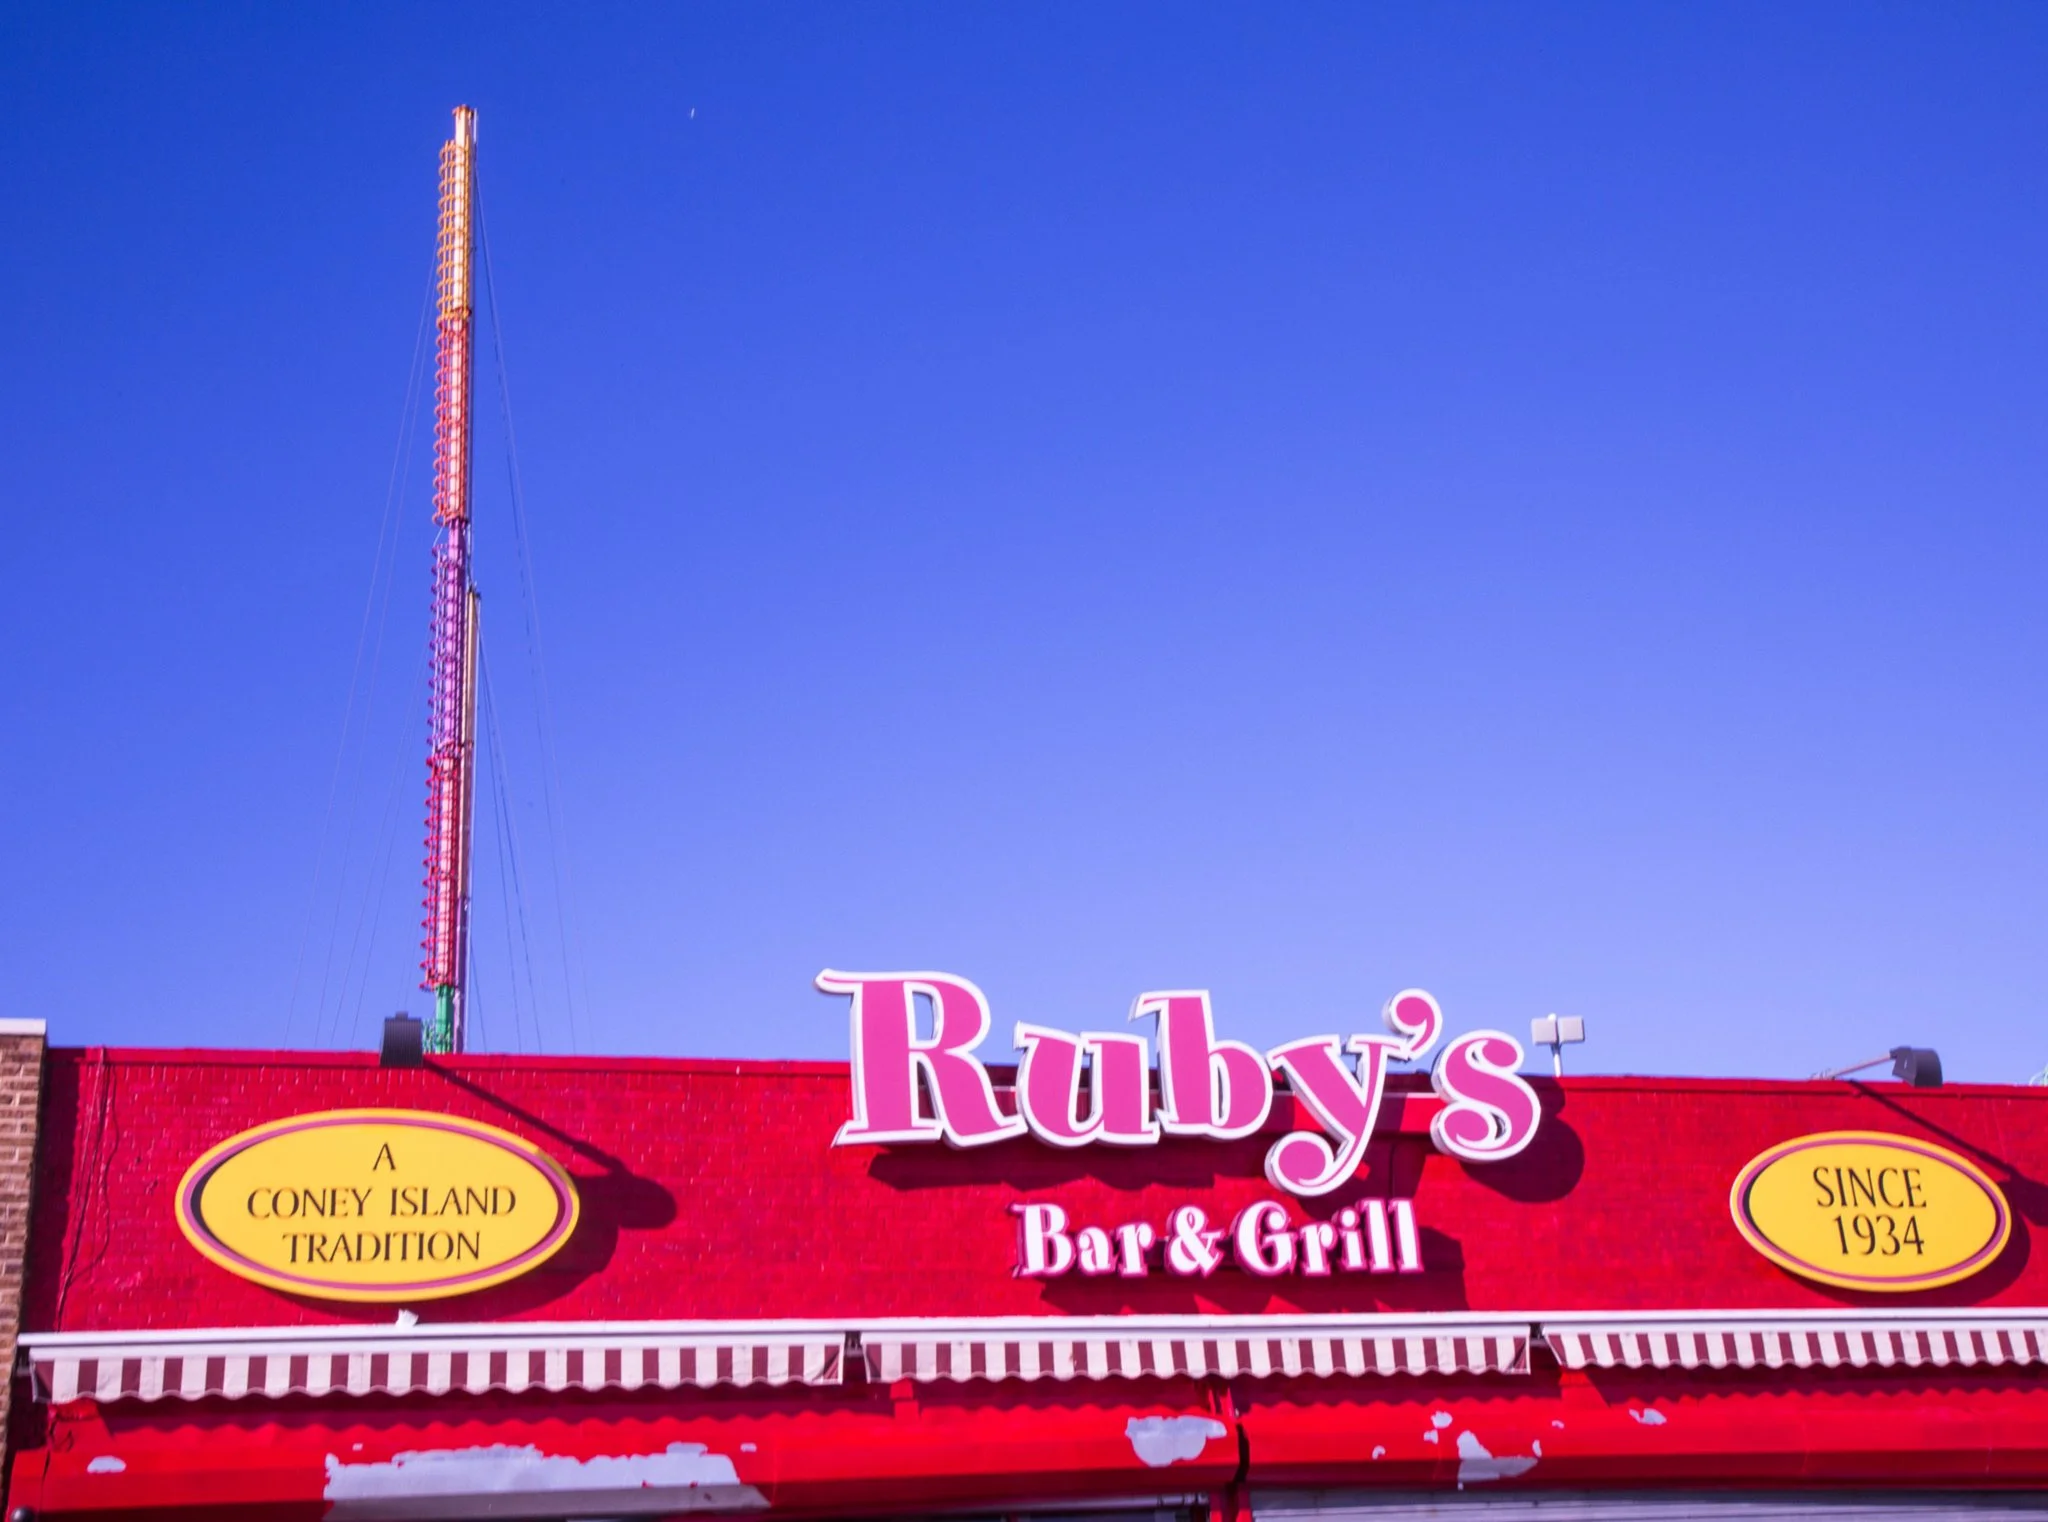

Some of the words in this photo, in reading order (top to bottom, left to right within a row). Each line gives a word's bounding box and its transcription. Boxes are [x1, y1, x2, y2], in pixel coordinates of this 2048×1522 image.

[815, 968, 1541, 1195] Ruby's
[372, 1142, 396, 1171] A
[247, 1187, 372, 1219] CONEY
[389, 1186, 516, 1217] ISLAND
[1813, 1166, 1927, 1208] SINCE
[282, 1231, 481, 1263] TRADITION
[1011, 1201, 1156, 1278] Bar
[1166, 1203, 1224, 1276] &
[1232, 1198, 1423, 1275] Grill
[1833, 1214, 1924, 1256] 1934
